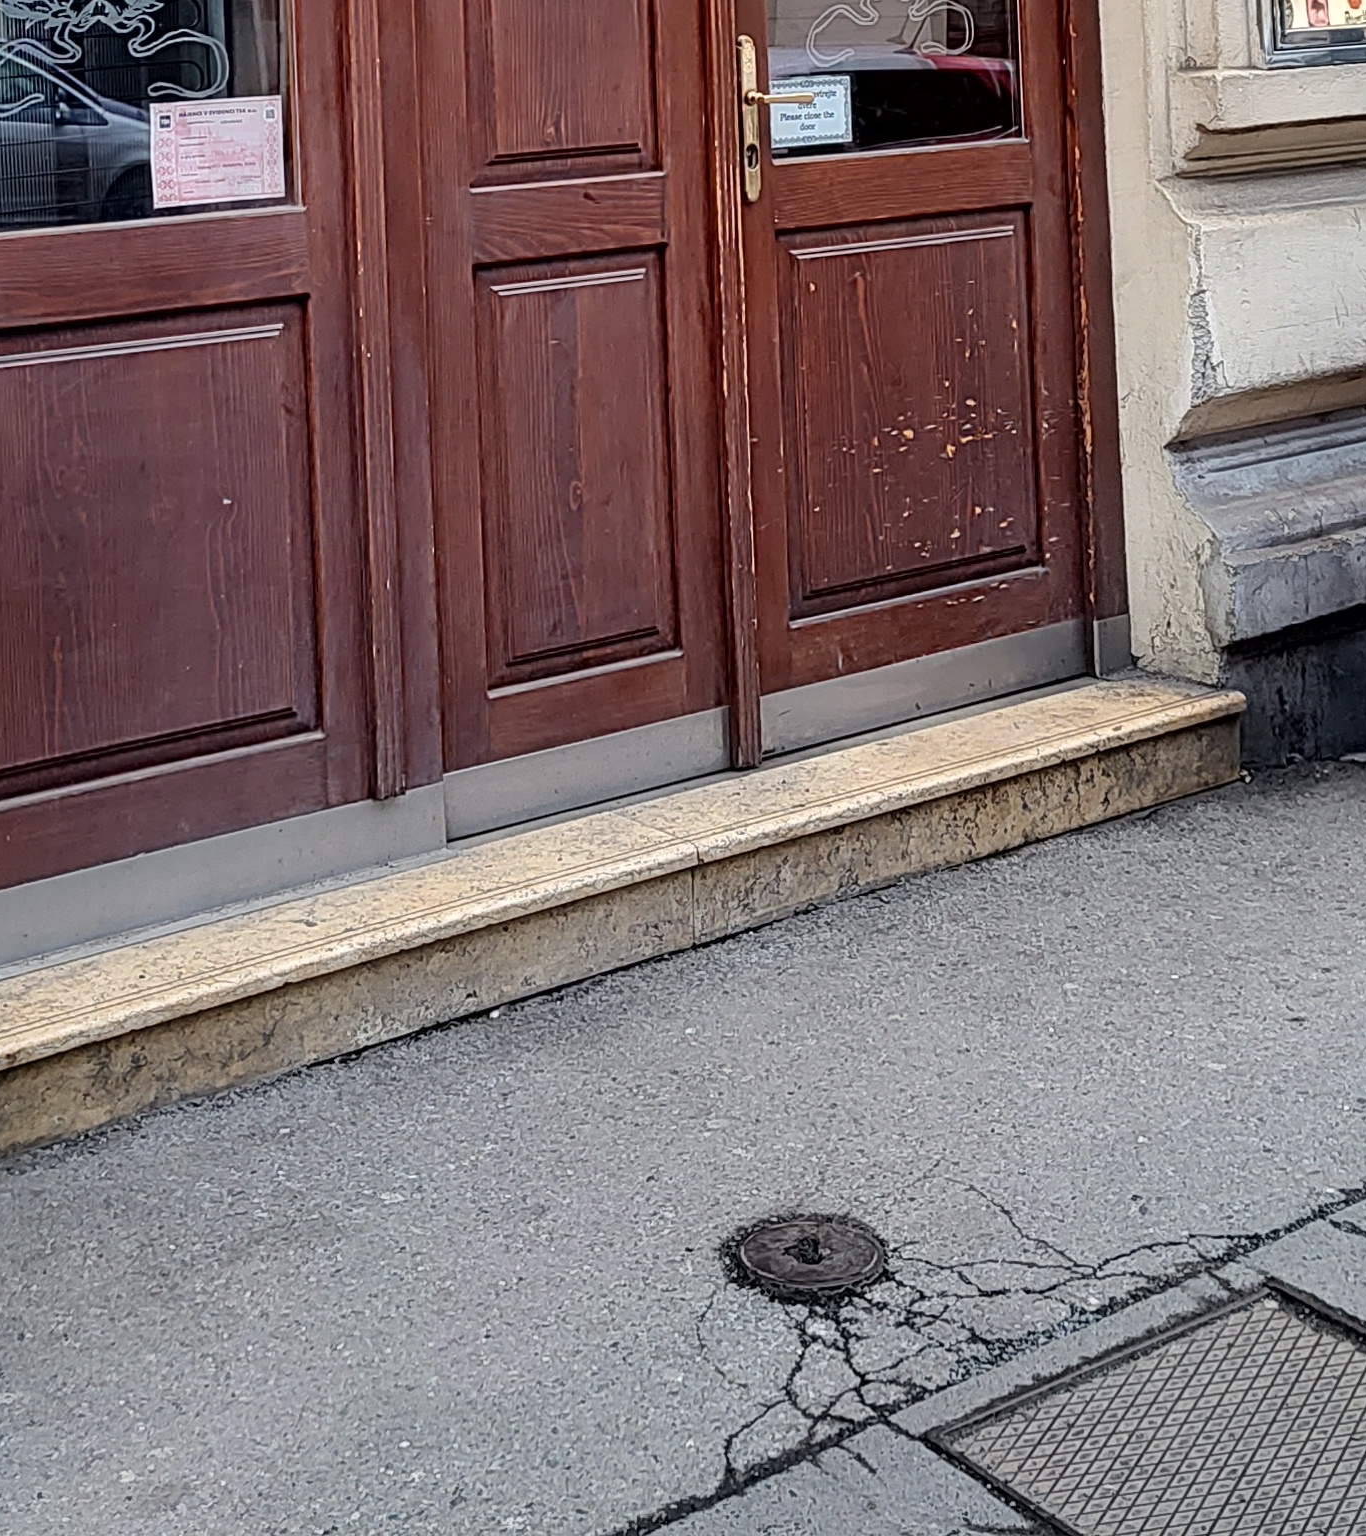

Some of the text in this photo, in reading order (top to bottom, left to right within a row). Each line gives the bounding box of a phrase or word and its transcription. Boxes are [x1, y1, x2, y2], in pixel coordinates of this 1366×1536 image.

[779, 110, 836, 122] Please close the
[799, 122, 817, 132] door
